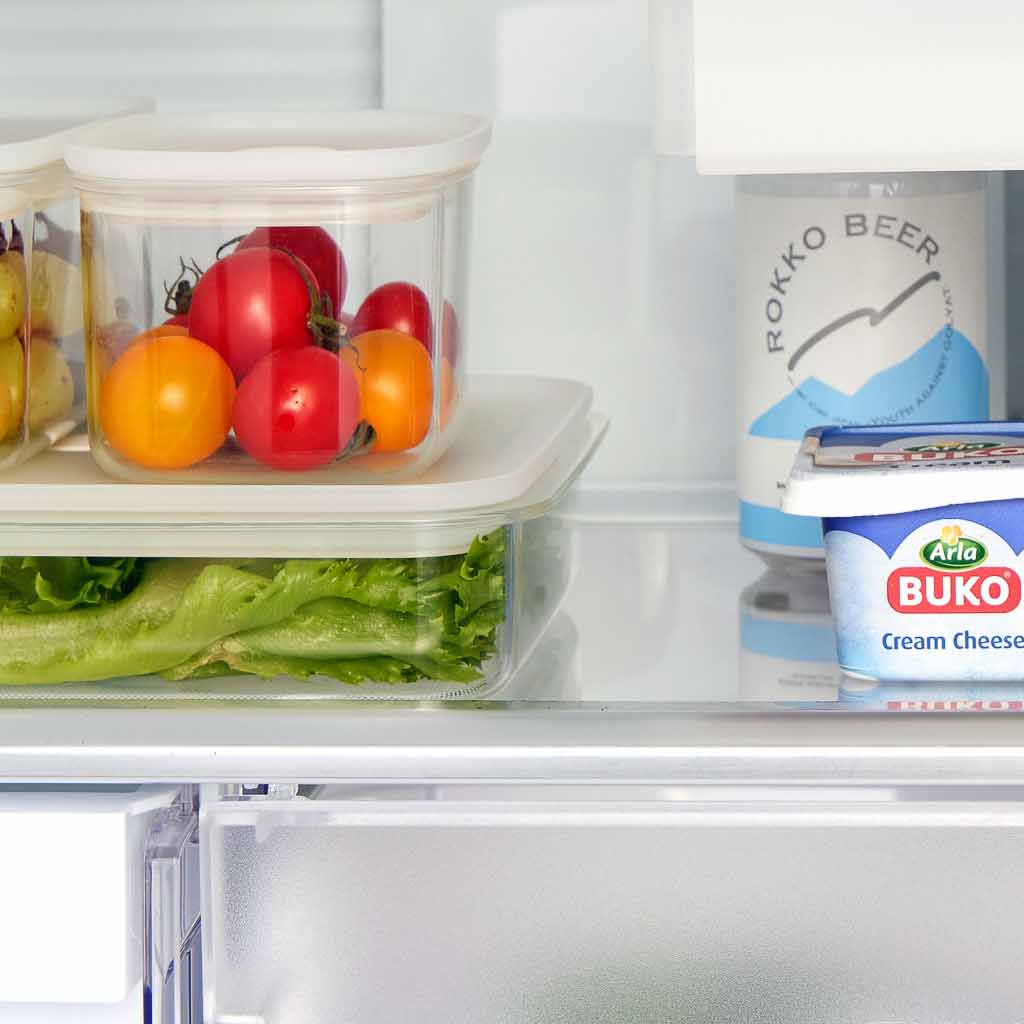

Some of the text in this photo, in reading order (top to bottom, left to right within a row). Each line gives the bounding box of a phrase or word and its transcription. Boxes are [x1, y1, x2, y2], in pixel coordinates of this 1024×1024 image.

[766, 213, 940, 353] ROKKO BEER
[929, 542, 977, 561] Arla
[898, 575, 1010, 607] BUKO
[881, 632, 947, 650] Cream
